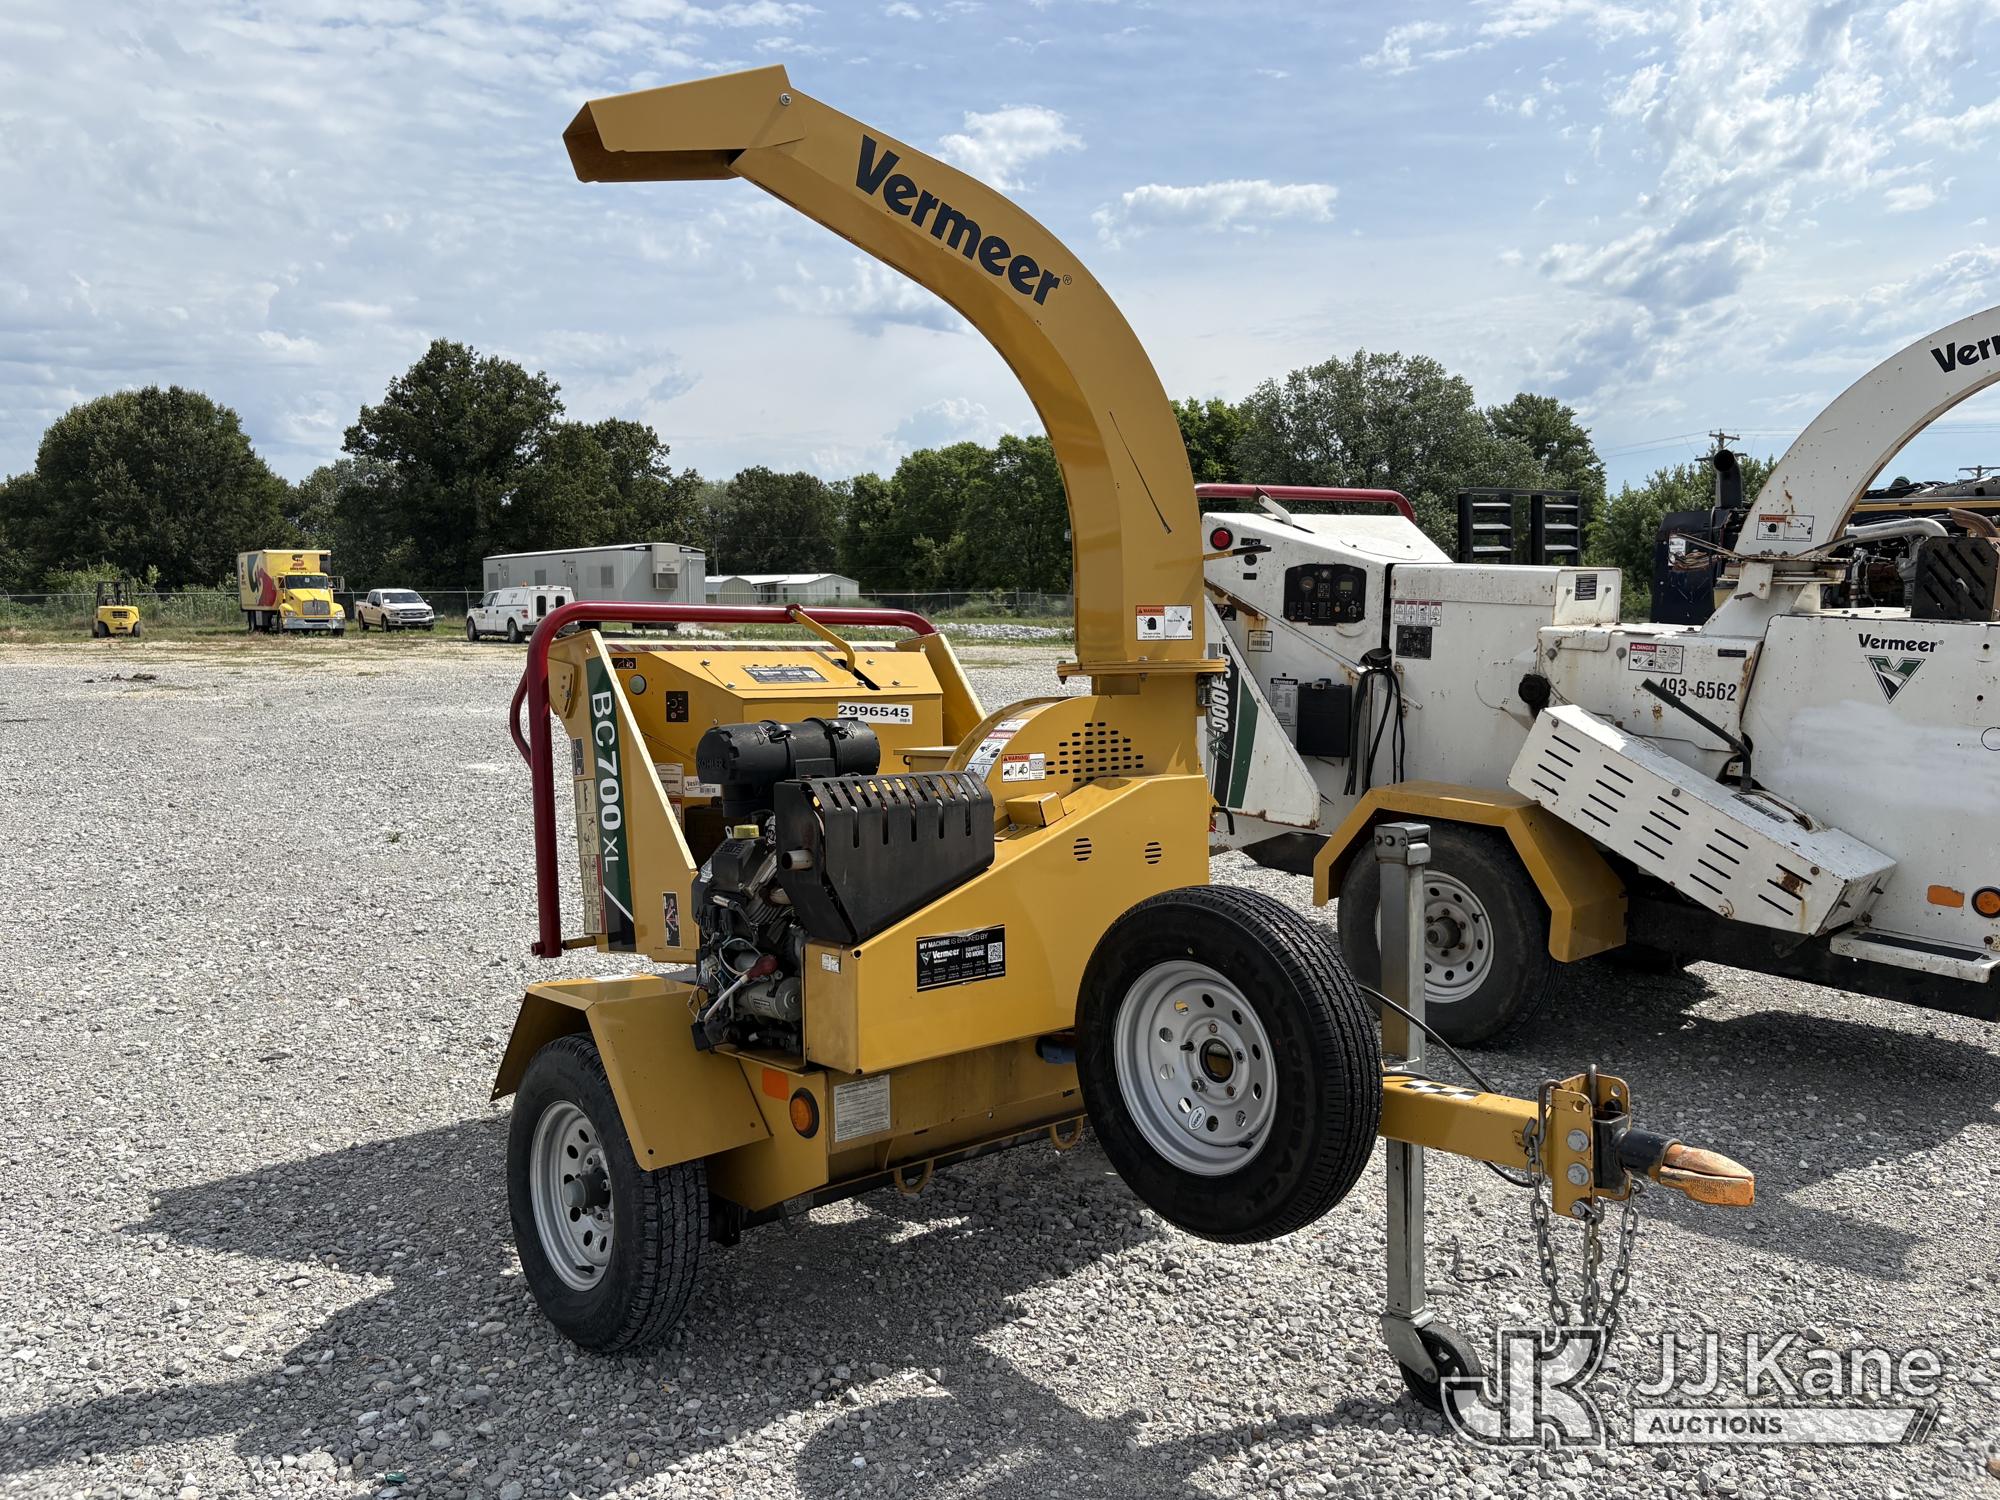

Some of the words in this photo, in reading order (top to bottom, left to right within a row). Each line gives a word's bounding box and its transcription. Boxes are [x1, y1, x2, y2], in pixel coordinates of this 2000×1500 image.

[855, 134, 1061, 306] Vermeer
[1858, 633, 1938, 653] Vermeer
[1660, 677, 1737, 702] 493-6562
[838, 704, 910, 718] 2996545
[592, 690, 622, 831] BC700
[602, 836, 620, 873] XL
[932, 949, 960, 959] Vermeer
